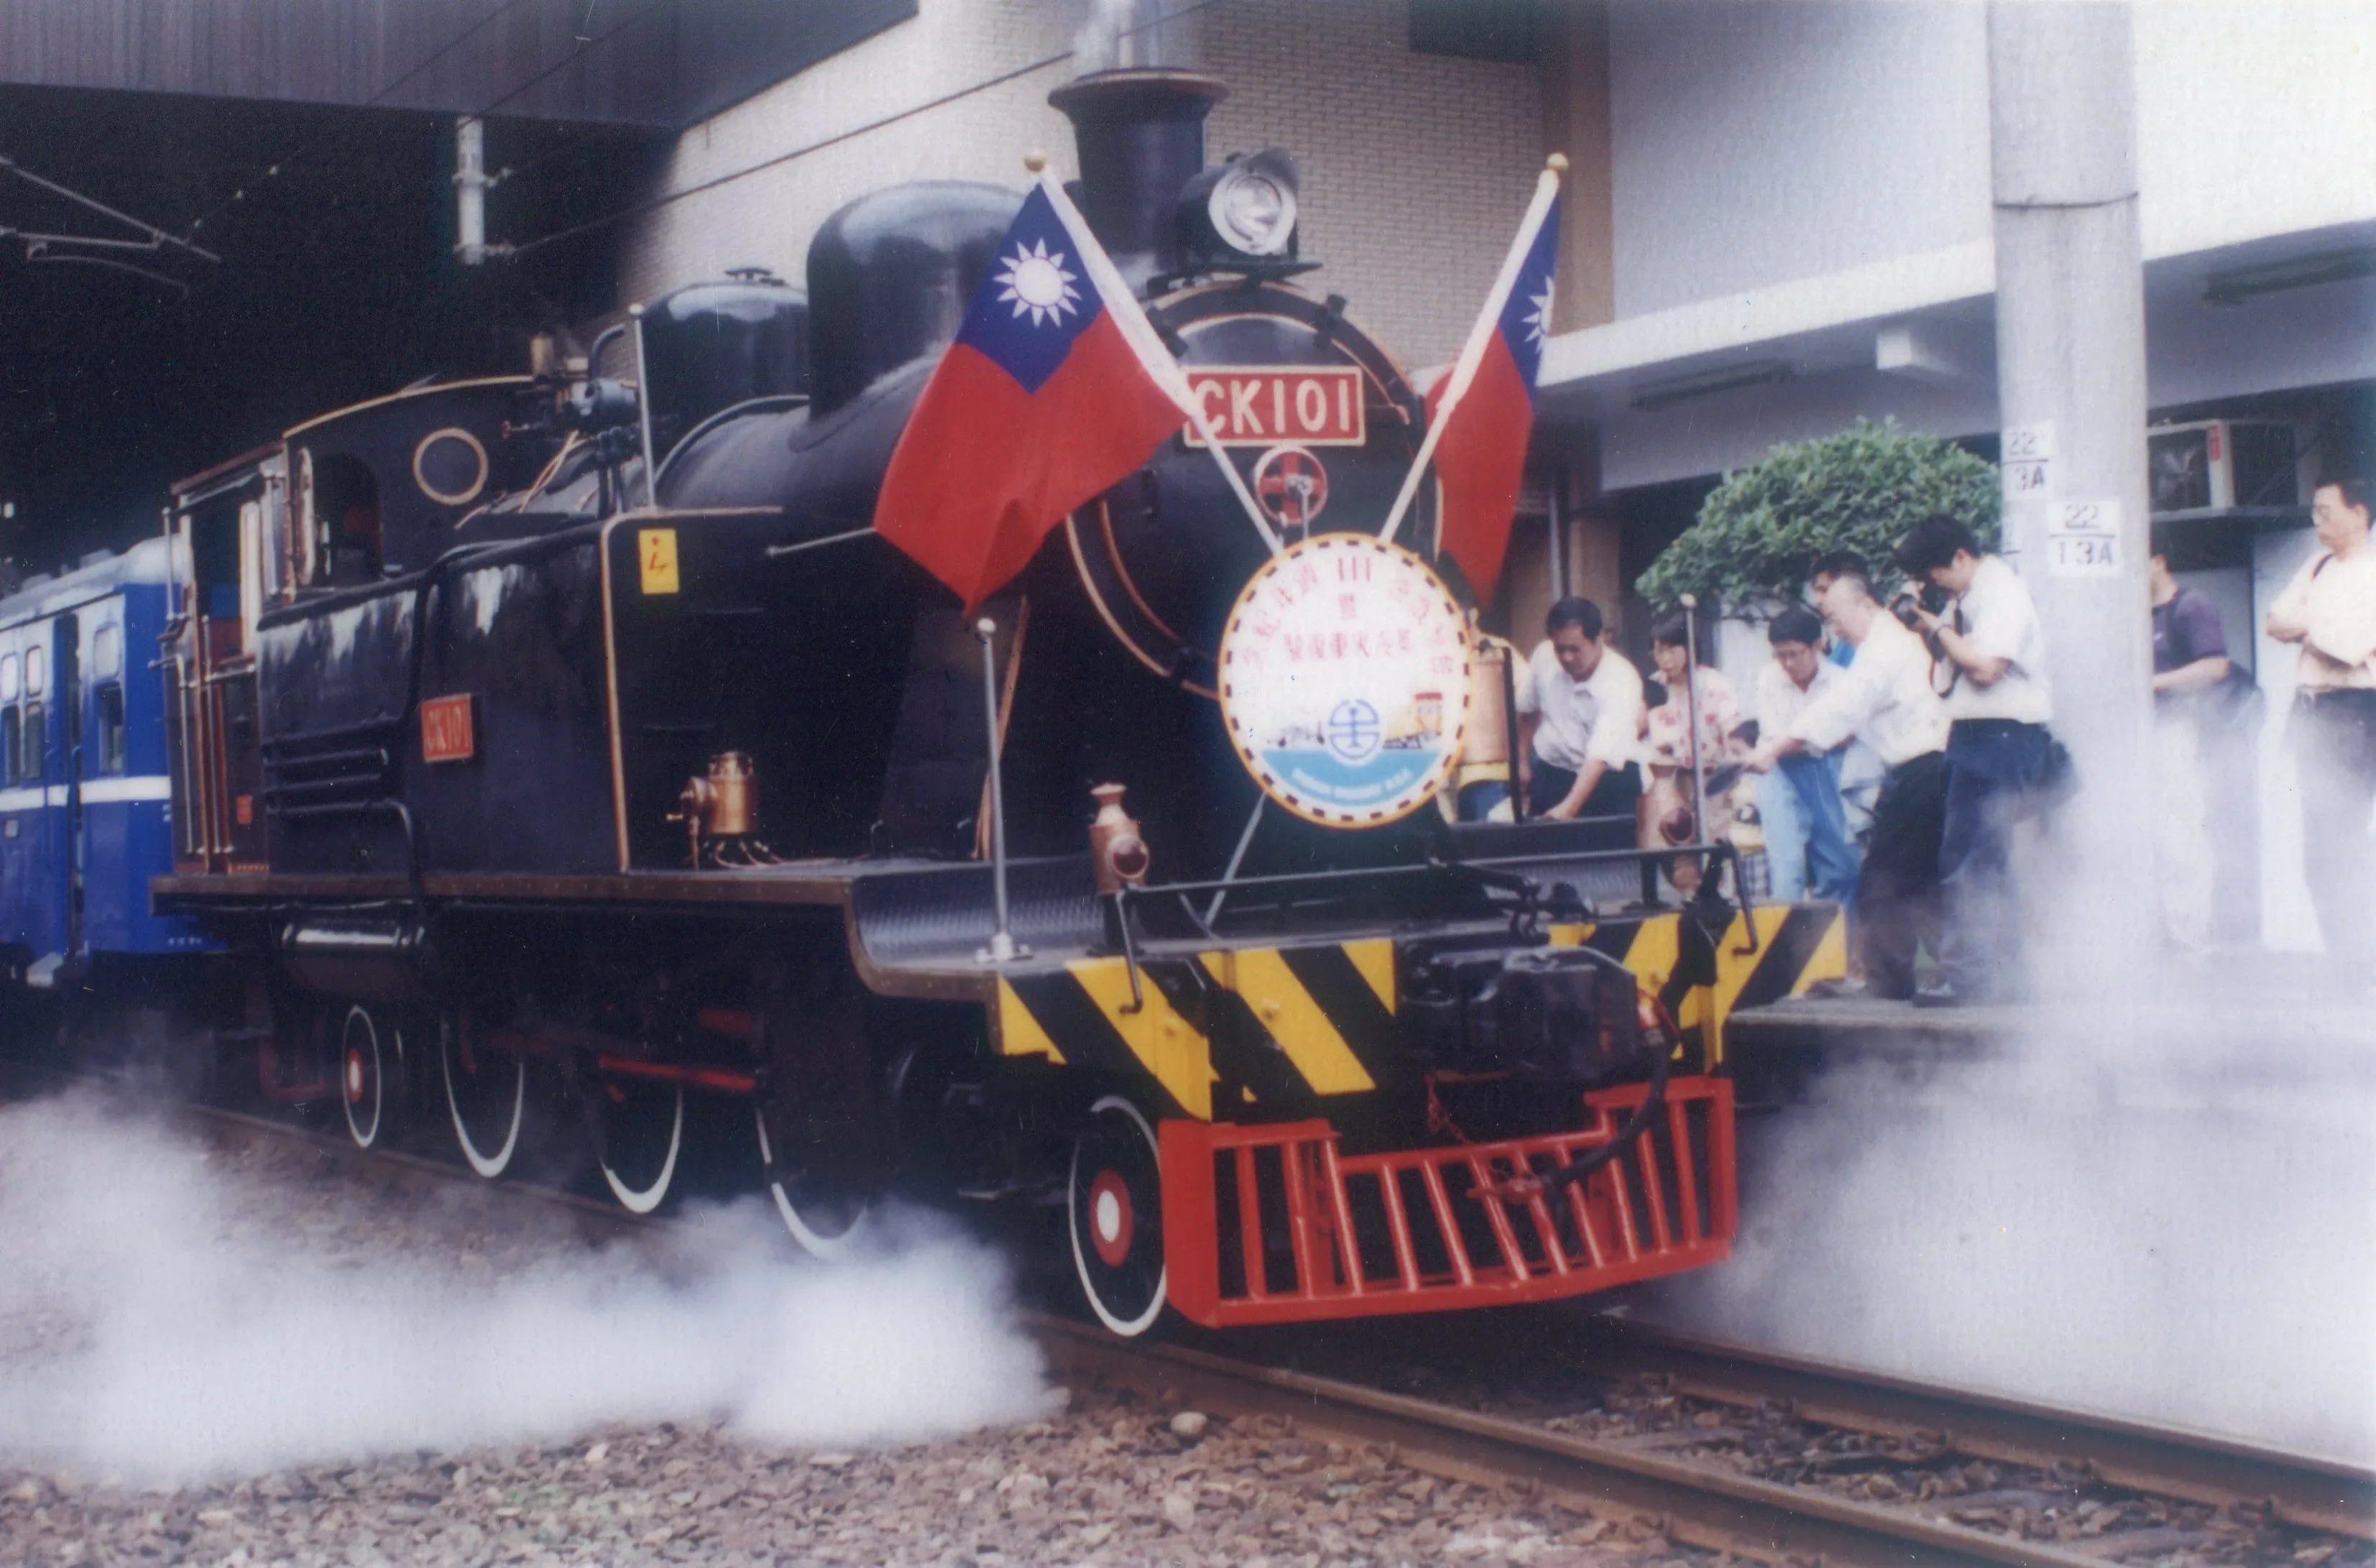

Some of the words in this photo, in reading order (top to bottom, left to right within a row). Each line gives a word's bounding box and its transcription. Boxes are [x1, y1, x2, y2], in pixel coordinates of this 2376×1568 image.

[1195, 379, 1350, 434] CK101
[2065, 504, 2099, 529] 22
[2058, 540, 2113, 566] 13A
[425, 704, 469, 751] CK101
